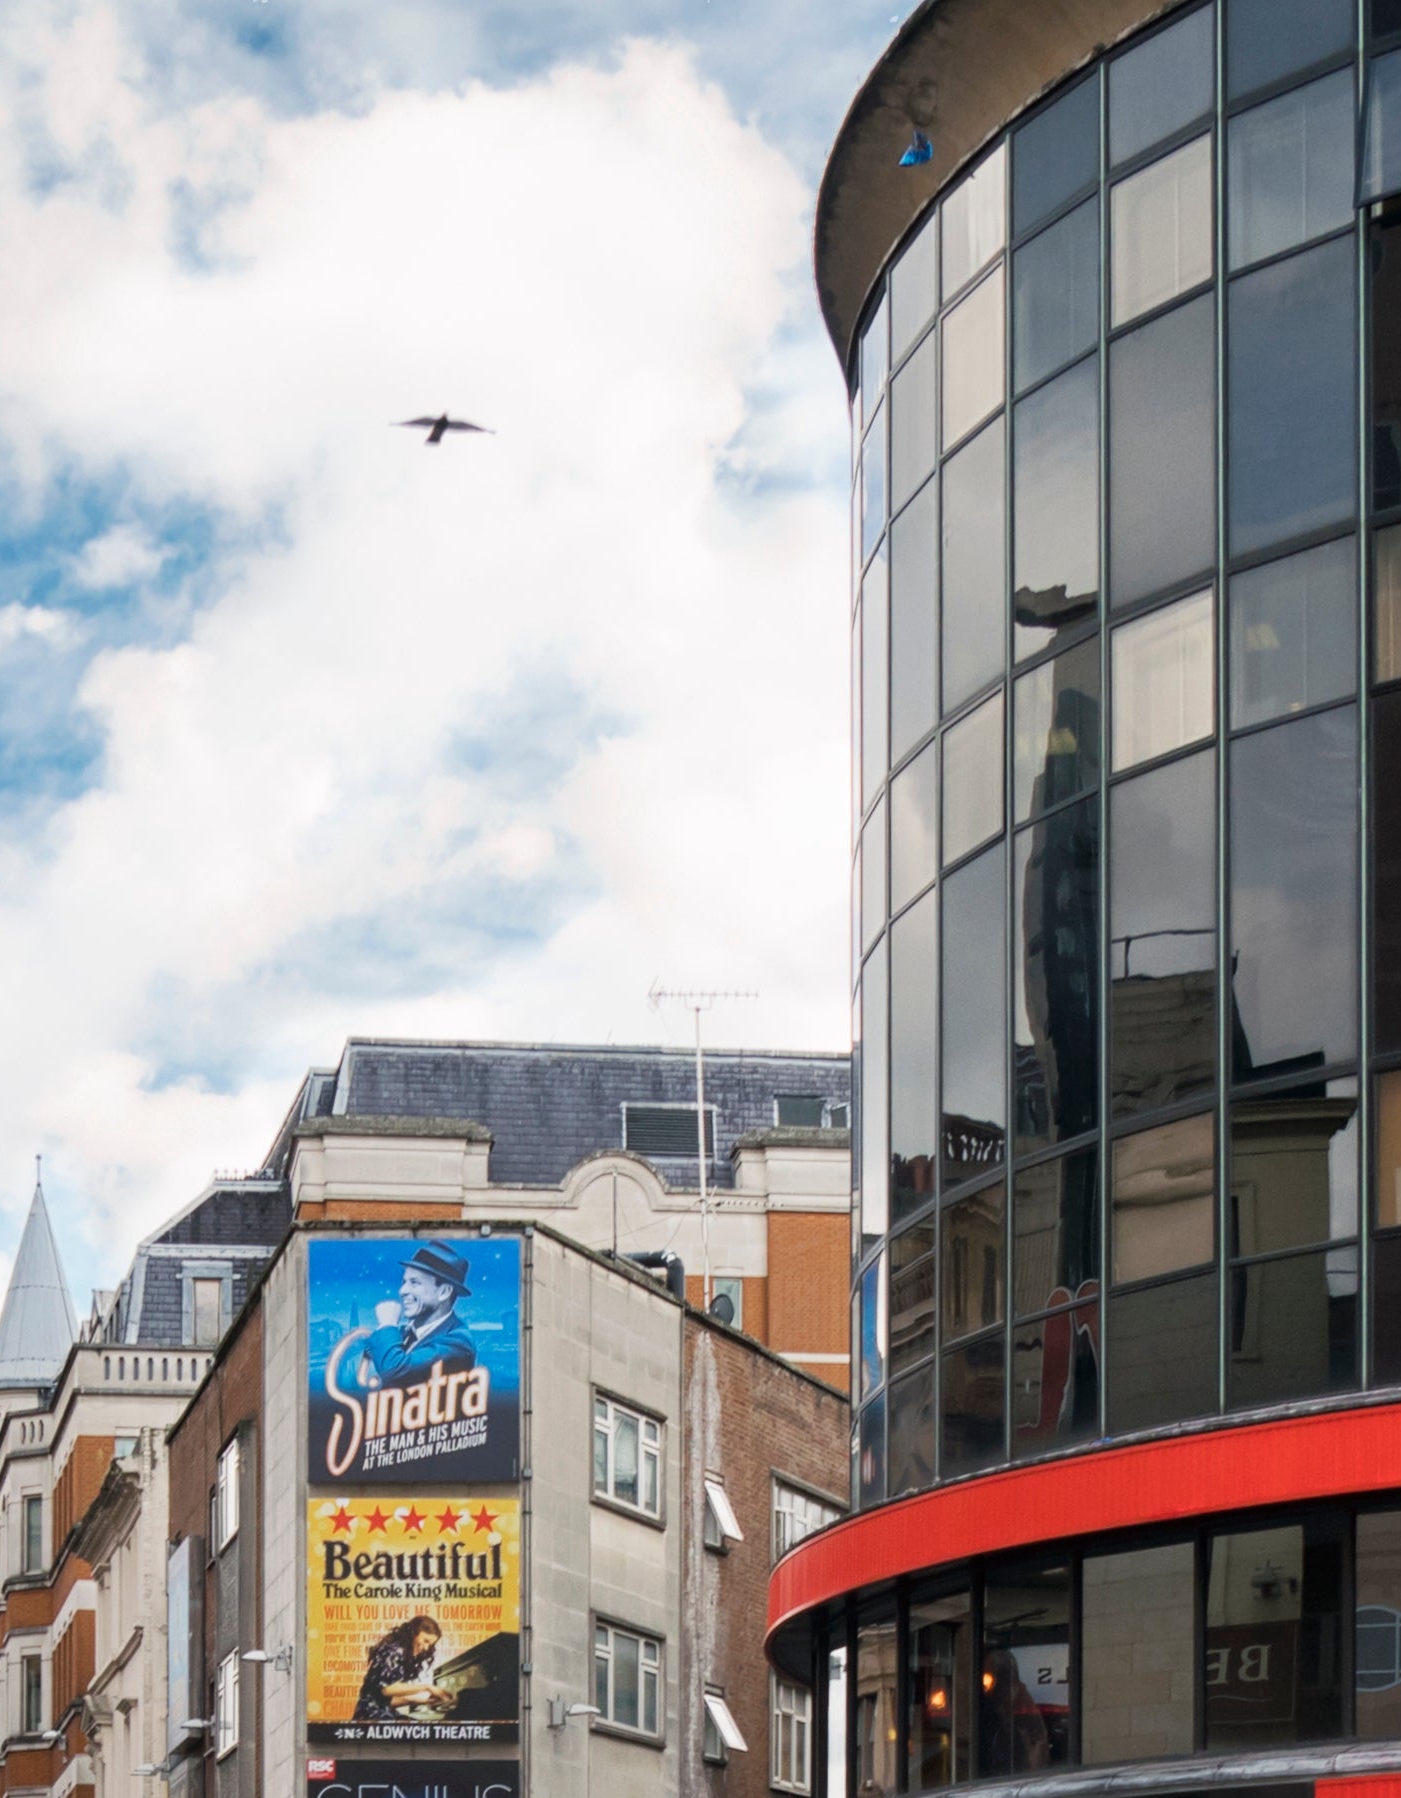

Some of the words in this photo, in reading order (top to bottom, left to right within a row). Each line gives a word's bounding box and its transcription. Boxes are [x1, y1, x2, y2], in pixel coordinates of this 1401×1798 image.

[325, 1327, 490, 1476] Sinatra
[362, 1456, 375, 1471] AT
[377, 1451, 395, 1468] THE
[396, 1443, 433, 1463] LONDON
[435, 1432, 487, 1455] PALLADIUM
[365, 1437, 387, 1456] THE
[389, 1431, 415, 1451] MAN
[417, 1429, 426, 1446] &
[428, 1424, 448, 1442] HIS
[451, 1415, 488, 1438] MUSIC
[322, 1540, 503, 1581] Beautiful
[323, 1583, 351, 1598] The
[354, 1583, 403, 1598] Carole
[405, 1583, 442, 1602] King
[444, 1582, 503, 1598] Musical
[324, 1604, 352, 1620] WILL
[357, 1604, 379, 1620] YOU
[383, 1604, 409, 1620] LOVE
[414, 1604, 431, 1620] ME
[435, 1604, 503, 1620] TOMORROW
[366, 1725, 430, 1739] ALDWYCH
[434, 1725, 492, 1739] THEATRE
